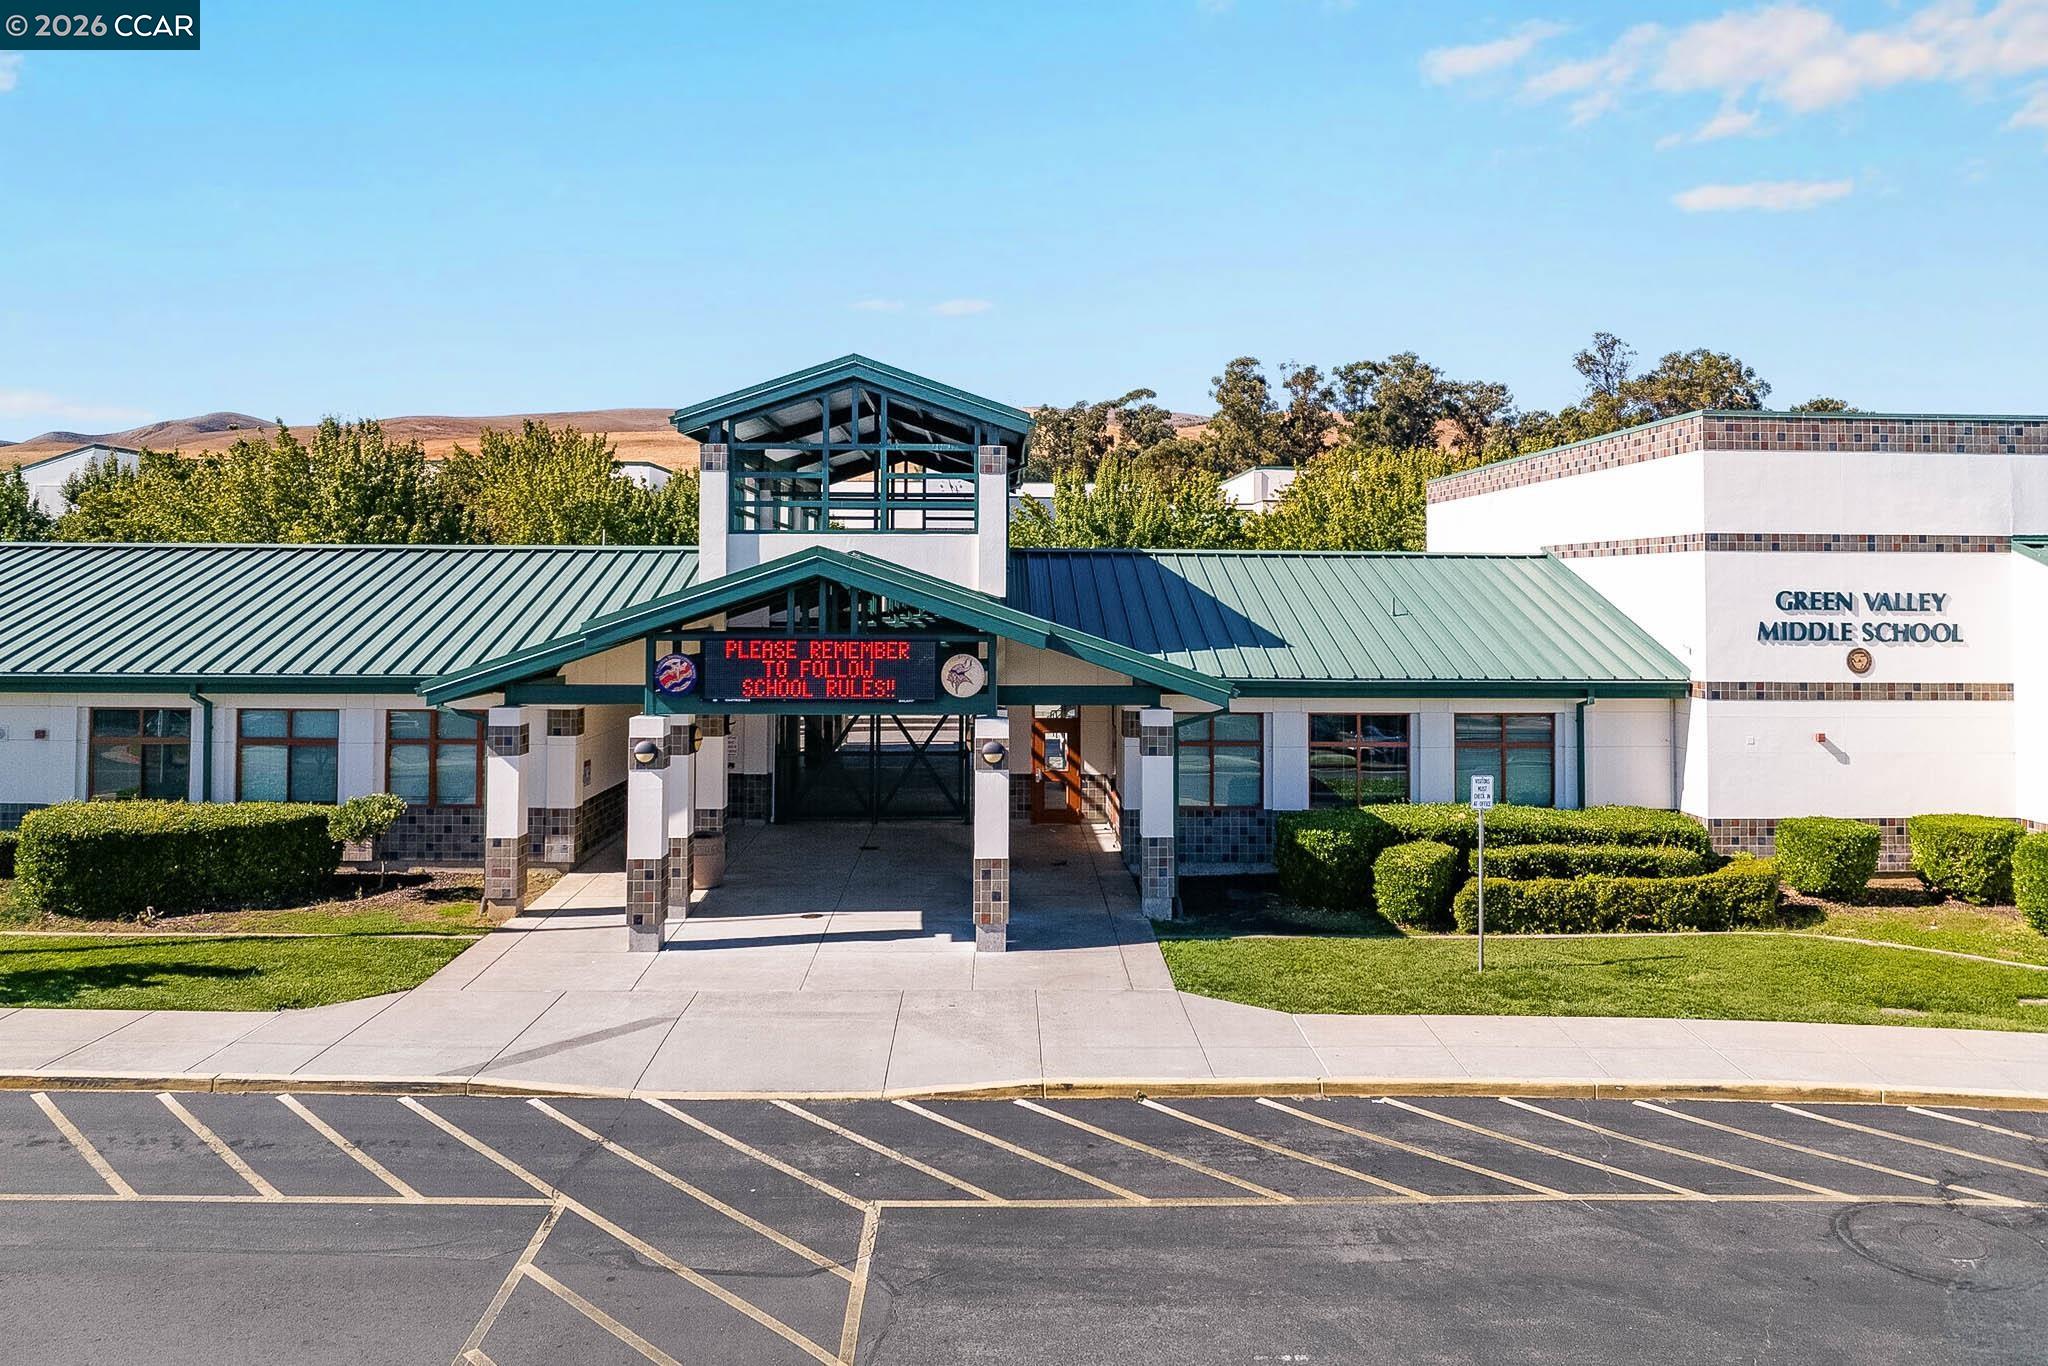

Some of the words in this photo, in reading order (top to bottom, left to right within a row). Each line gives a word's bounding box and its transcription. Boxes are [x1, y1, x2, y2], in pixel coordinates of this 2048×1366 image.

[1775, 590, 1853, 612] GREEN
[1863, 592, 1947, 612] VALLEY
[1757, 621, 1853, 642] MIDDLE
[1861, 622, 1964, 643] SCHOOL
[725, 640, 797, 659] PLEASE
[810, 640, 910, 659] REMEMBER
[762, 660, 788, 678] TO
[800, 660, 874, 678] FOLLOW
[742, 678, 813, 697] SCHOOL
[826, 679, 896, 697] RULES!!
